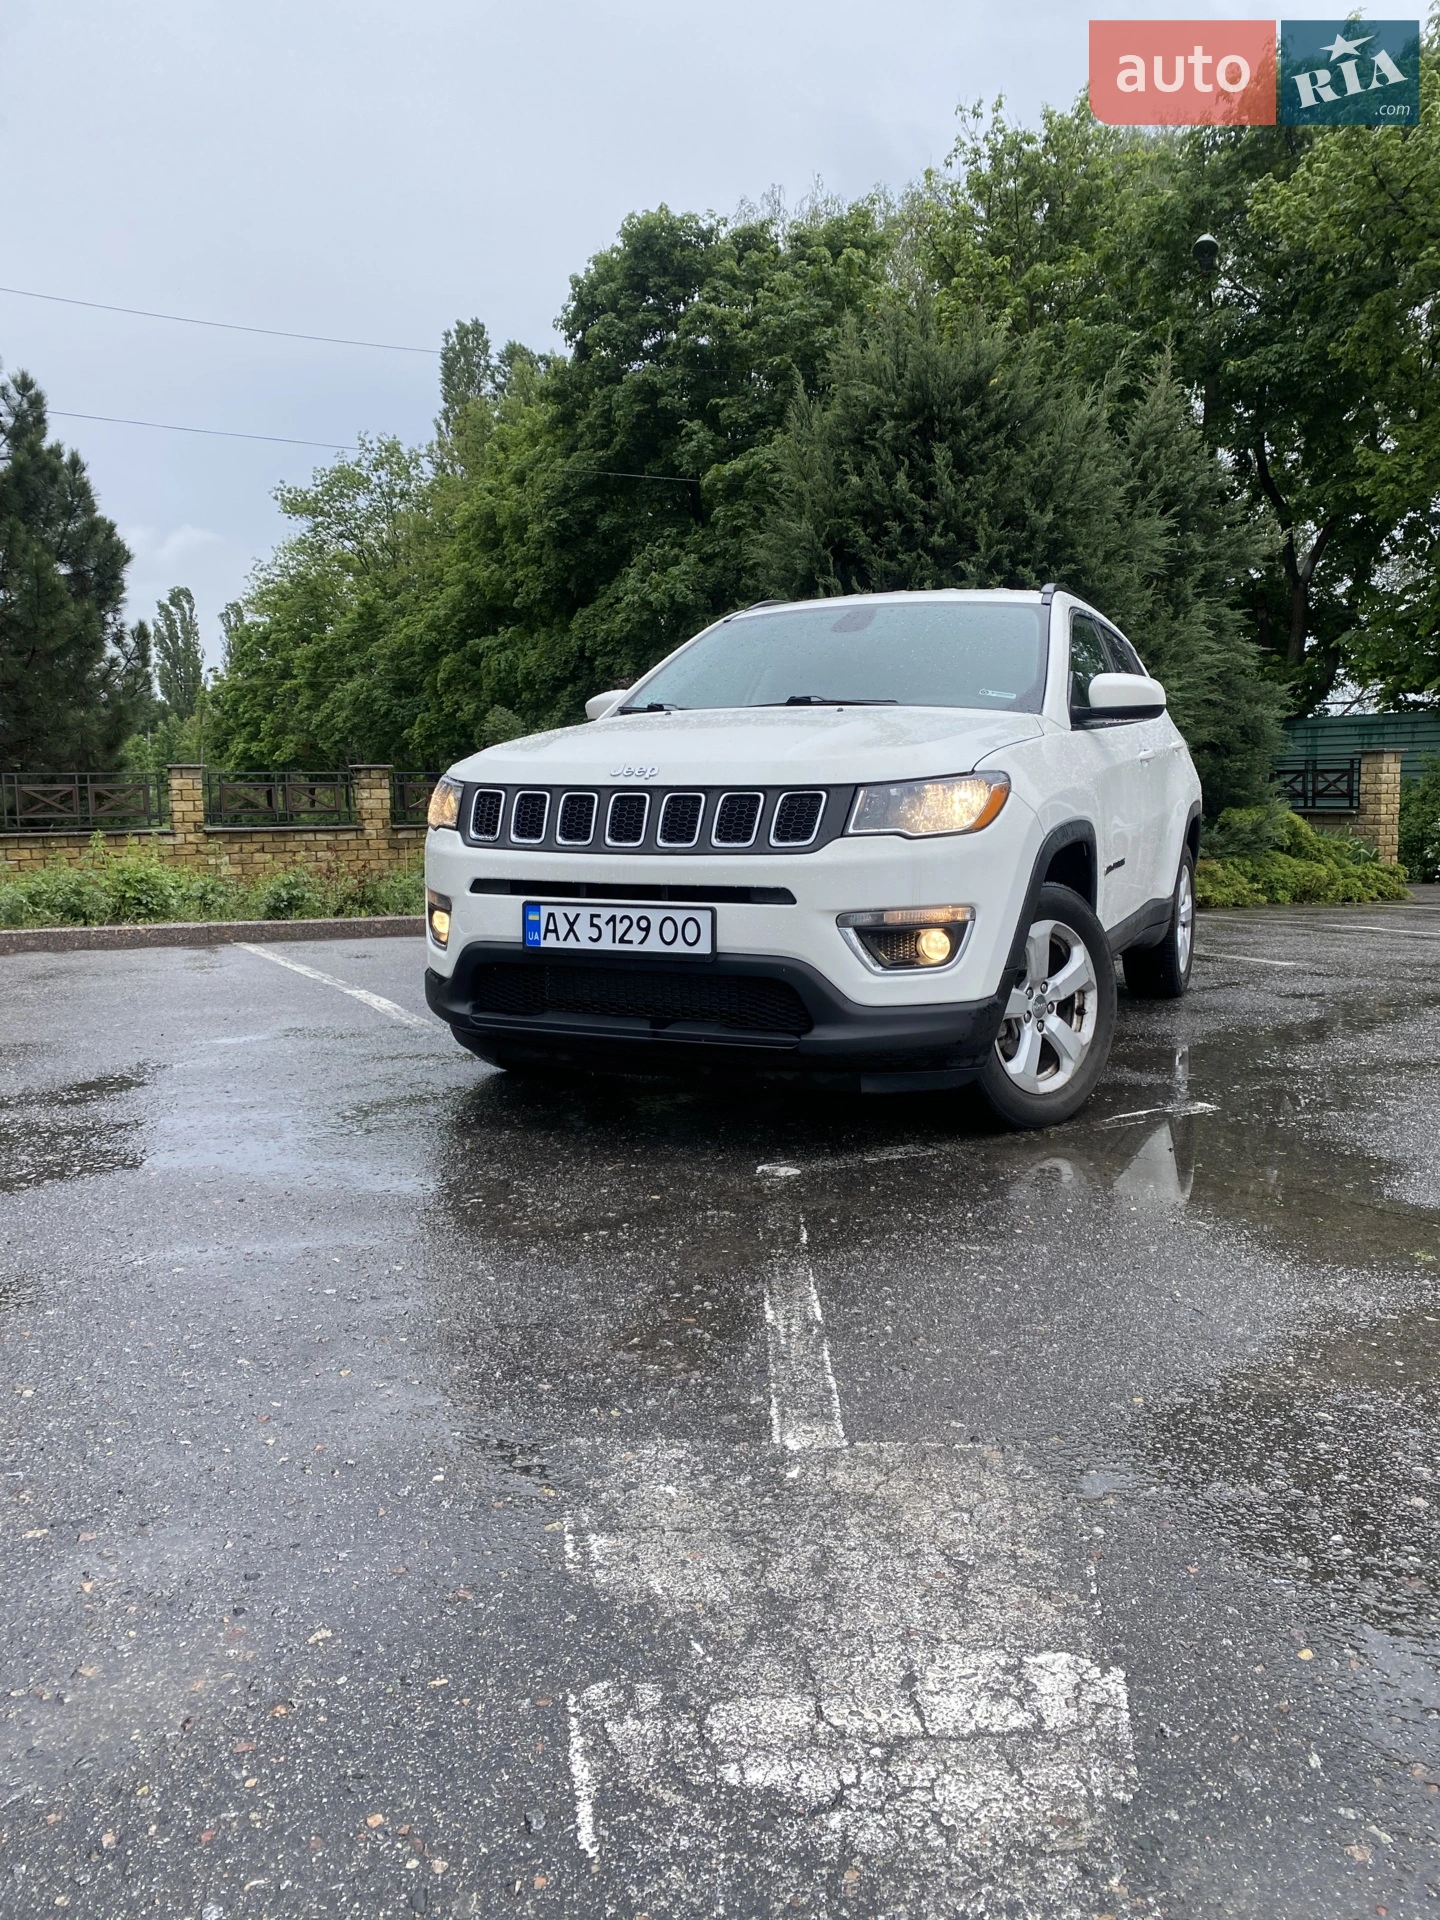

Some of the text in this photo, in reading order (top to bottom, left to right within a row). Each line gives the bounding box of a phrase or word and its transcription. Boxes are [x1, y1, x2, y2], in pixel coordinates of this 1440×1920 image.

[609, 763, 660, 781] Jeep
[528, 931, 540, 941] UA
[542, 911, 702, 947] AX 5129 OO
